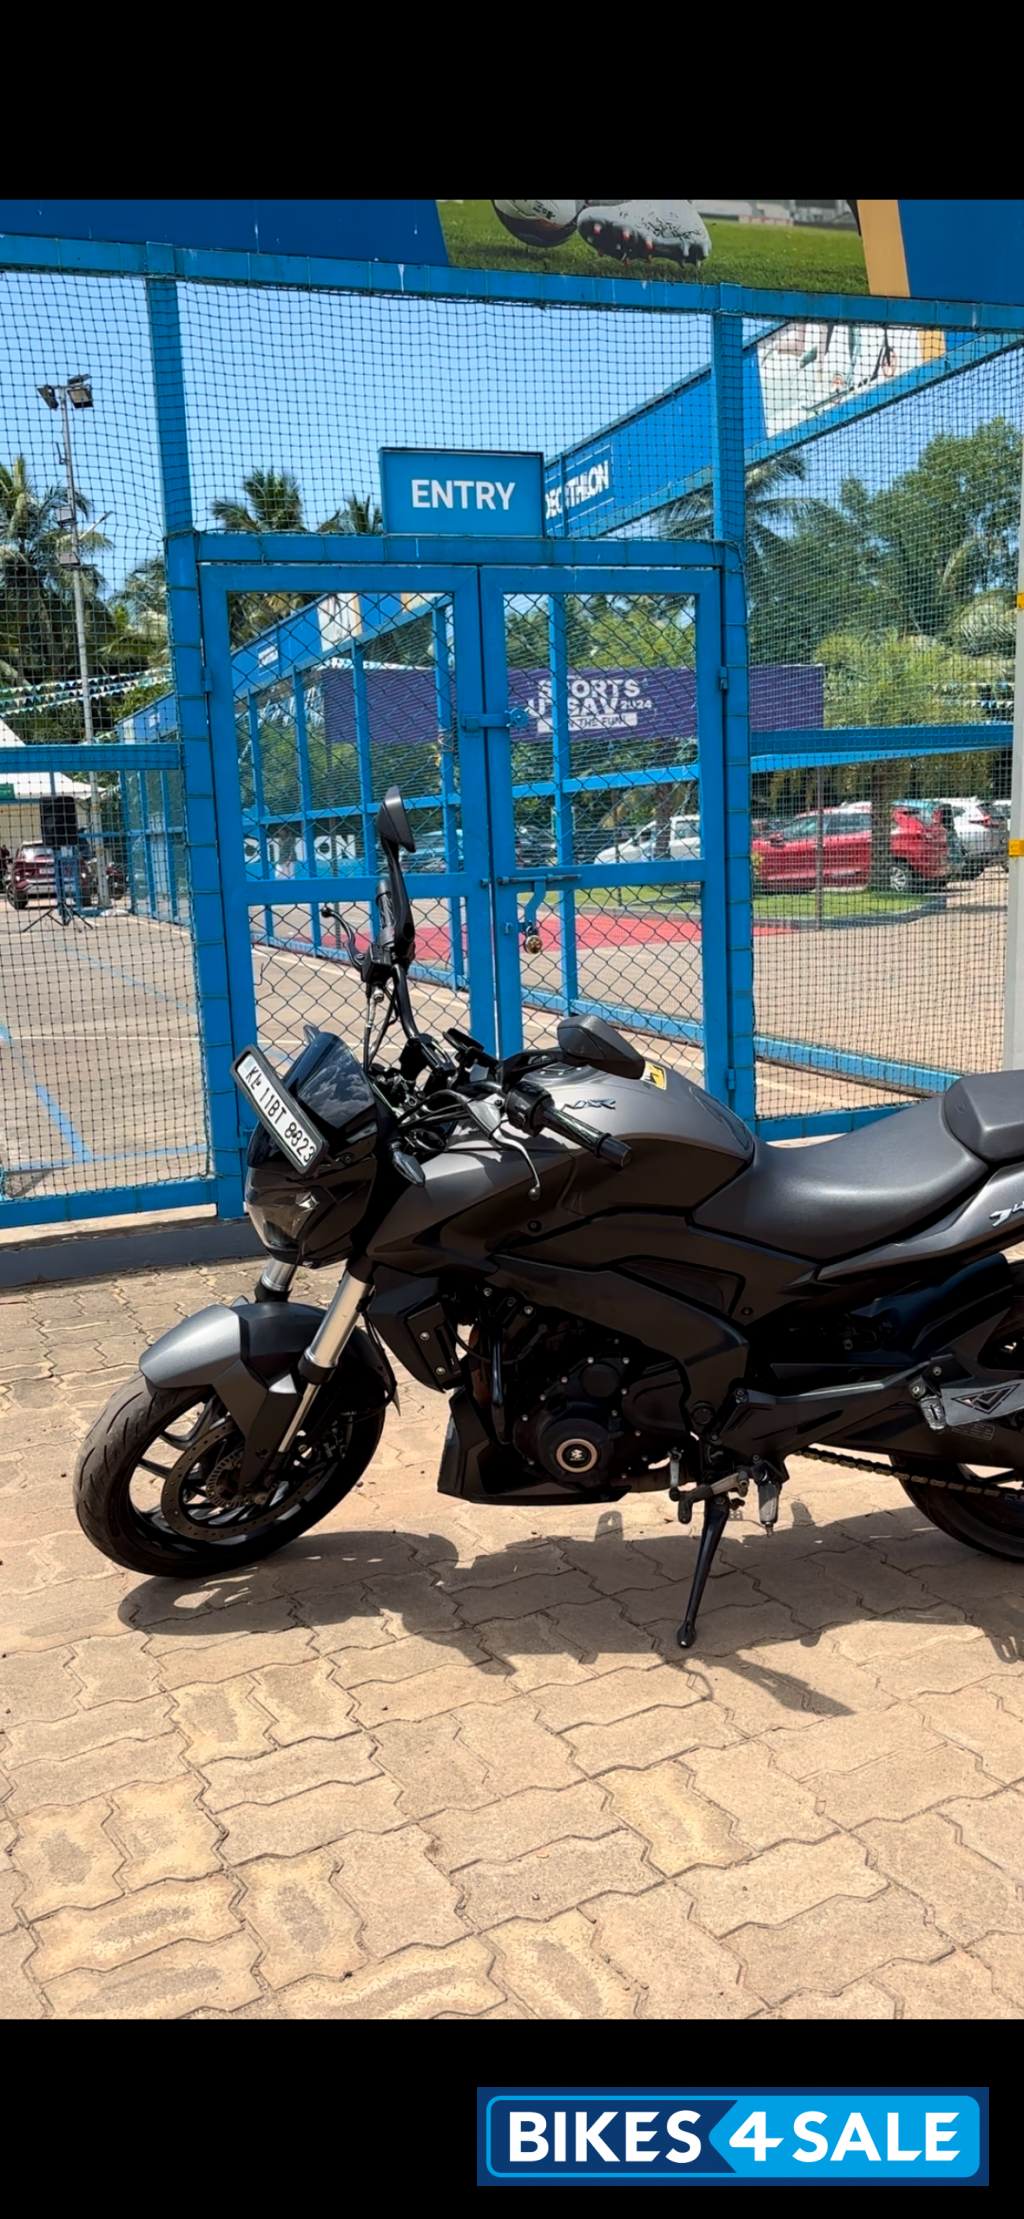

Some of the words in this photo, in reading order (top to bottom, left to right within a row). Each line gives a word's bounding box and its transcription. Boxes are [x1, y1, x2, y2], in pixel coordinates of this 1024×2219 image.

[411, 479, 516, 510] ENTRY
[538, 679, 641, 698] SORTS
[620, 699, 653, 710] 2024
[577, 718, 599, 728] THE
[245, 1066, 262, 1090] KL
[259, 1087, 287, 1124] 11BT
